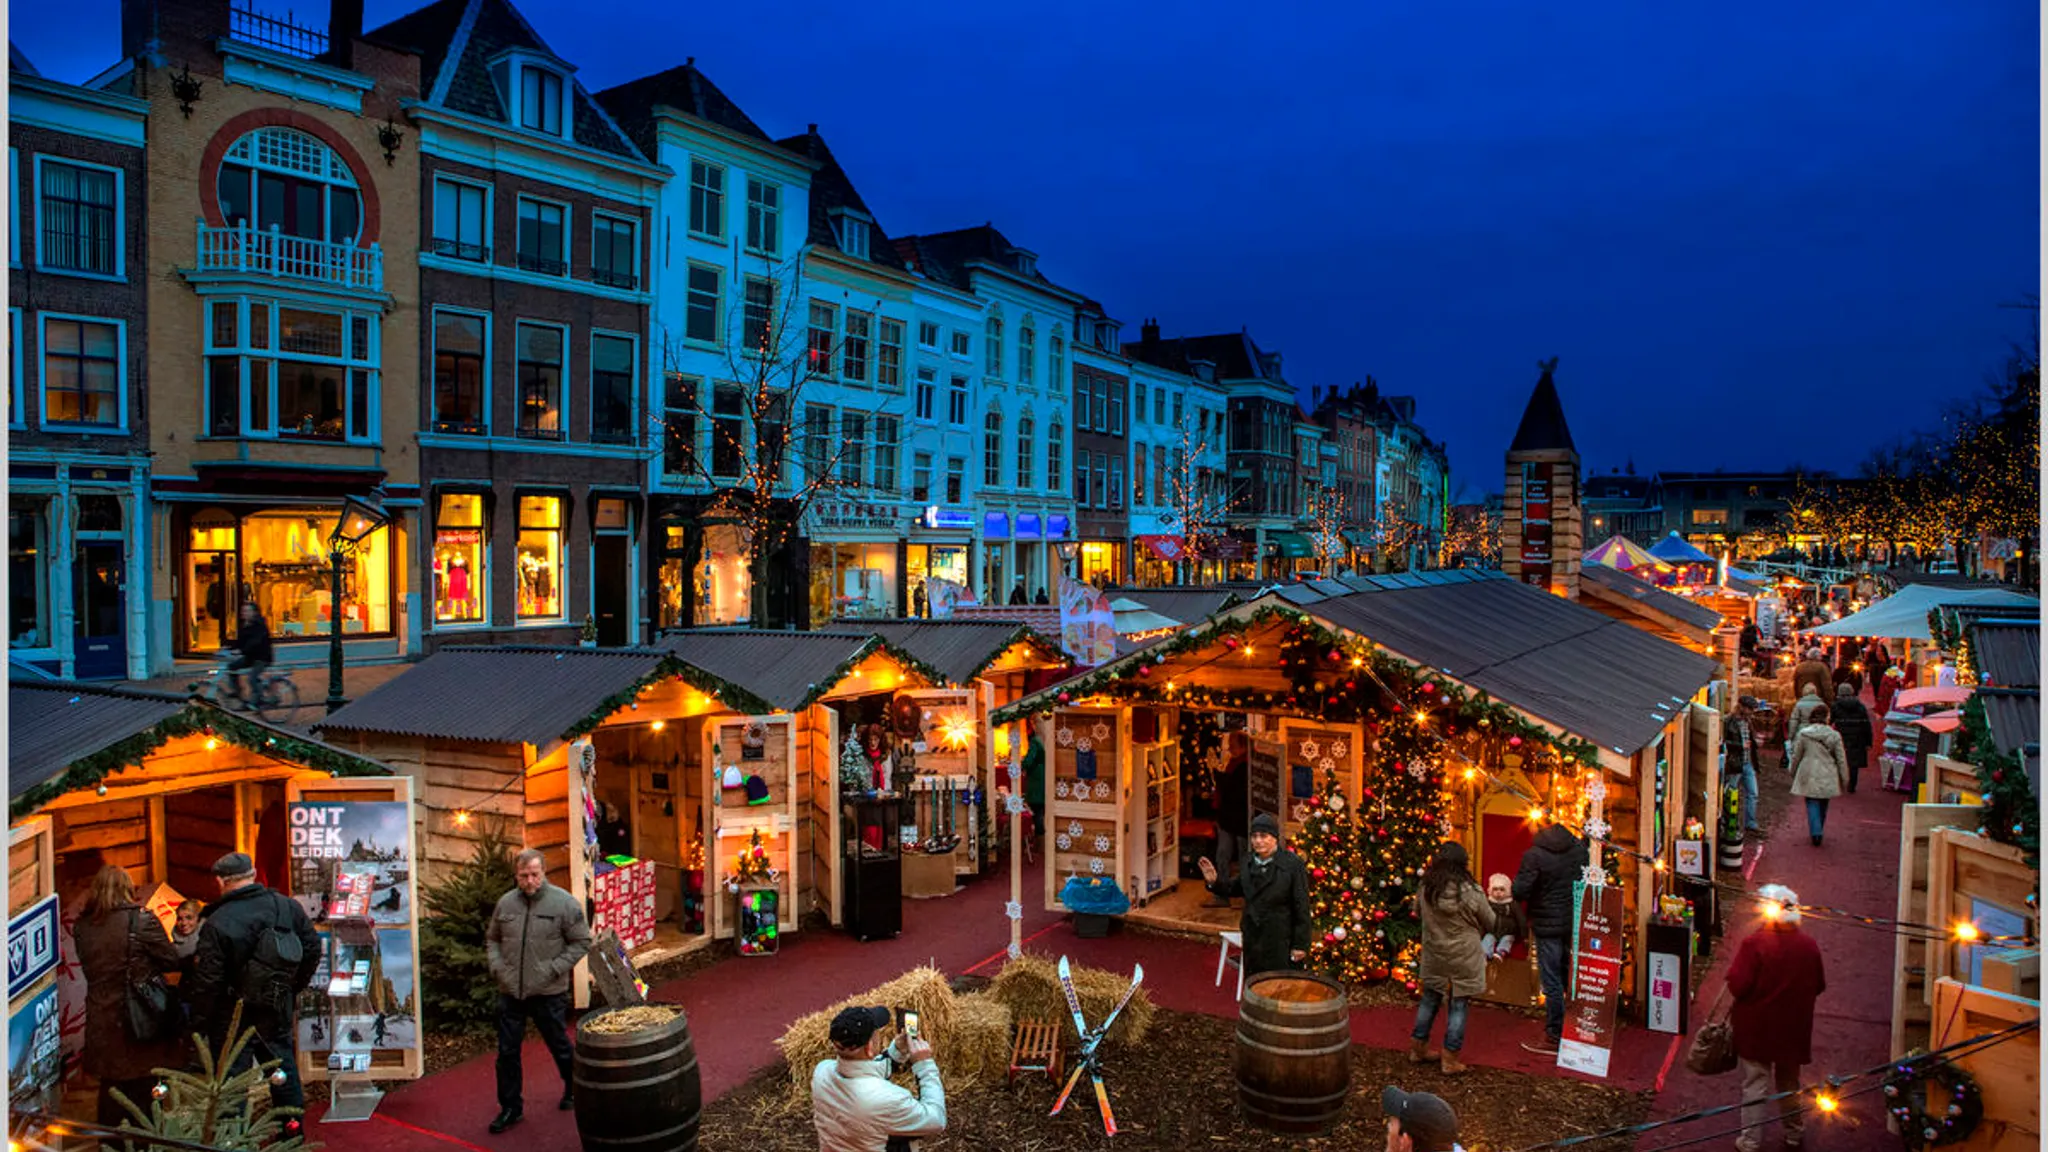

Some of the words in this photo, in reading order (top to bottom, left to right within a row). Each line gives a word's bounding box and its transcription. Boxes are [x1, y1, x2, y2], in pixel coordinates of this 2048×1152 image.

[290, 807, 345, 825] ONT
[291, 827, 343, 845] DEK
[291, 847, 343, 858] LEIDEN
[1655, 979, 1663, 996] ART
[35, 990, 59, 1024] ONT
[1655, 999, 1663, 1026] SHOP
[33, 1011, 60, 1049] DEK
[32, 1035, 60, 1063] LEIDE
